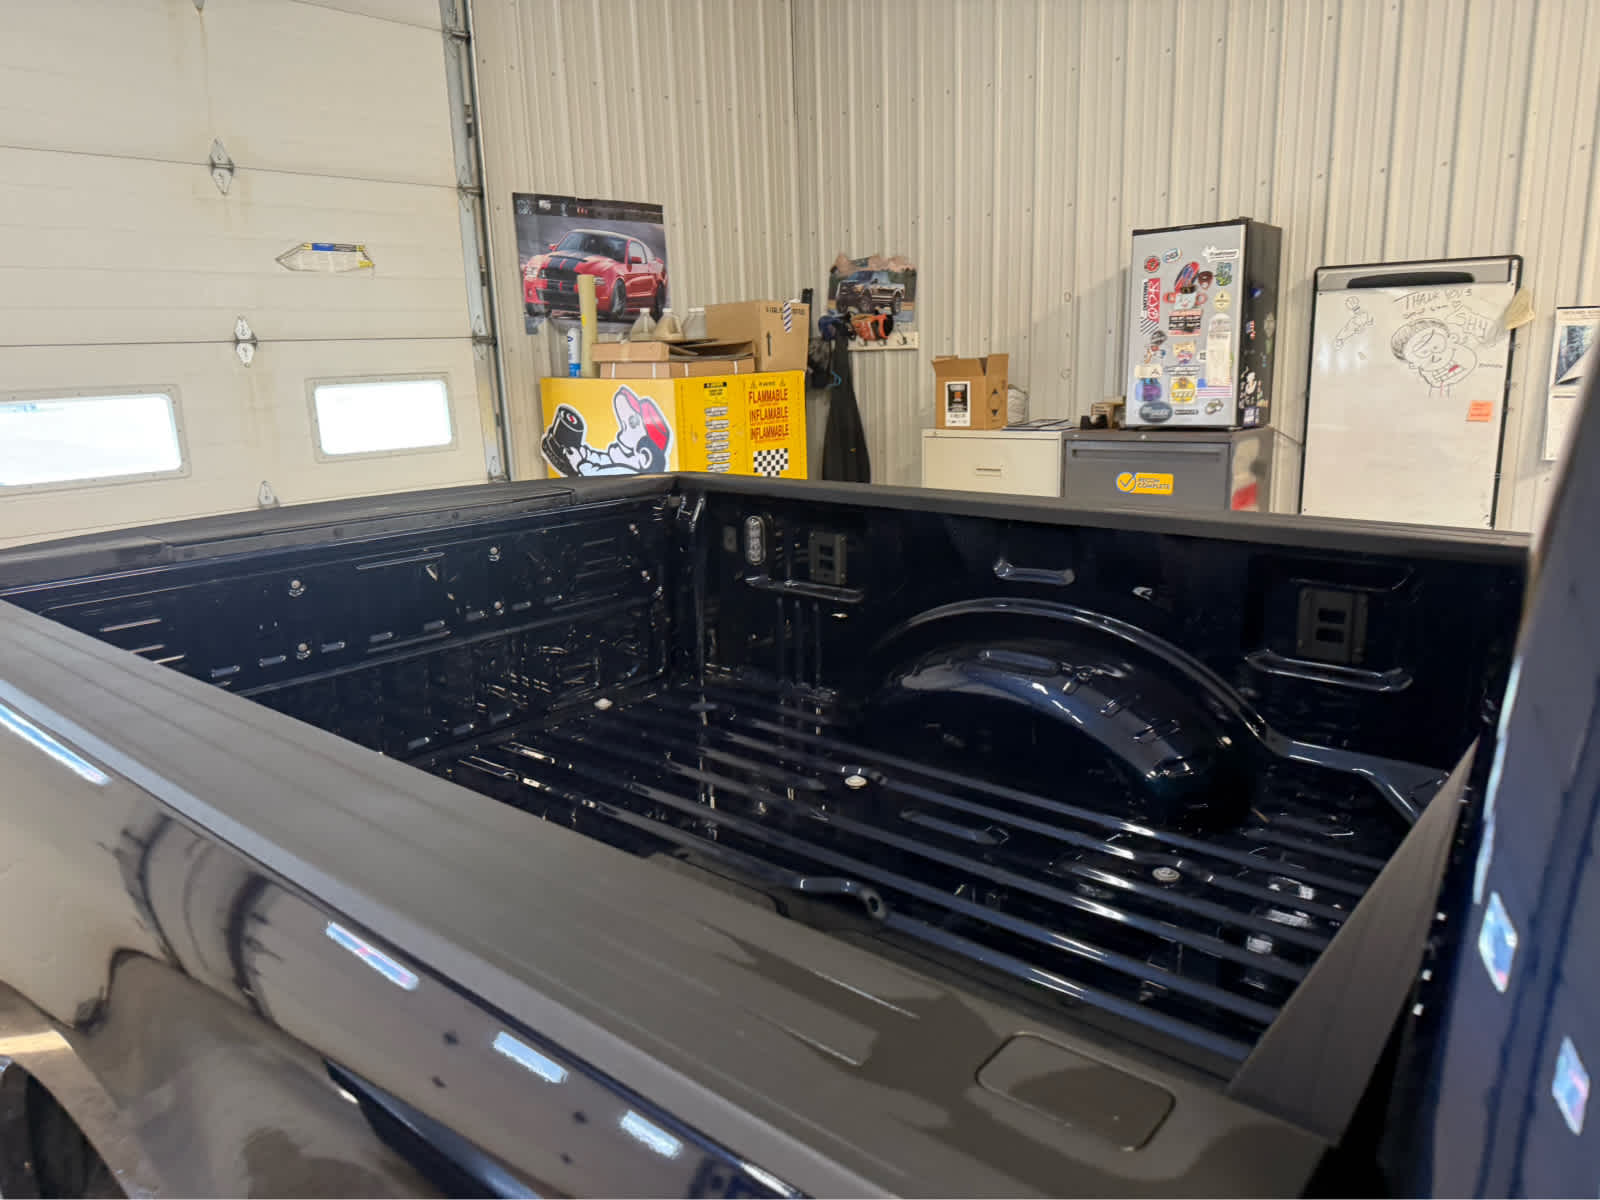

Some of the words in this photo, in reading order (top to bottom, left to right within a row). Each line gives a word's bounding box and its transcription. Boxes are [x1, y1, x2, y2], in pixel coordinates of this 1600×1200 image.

[748, 388, 788, 404] FLAMMABLE
[750, 406, 789, 422] INFLAMABLE
[1137, 482, 1170, 490] COMPLETE
